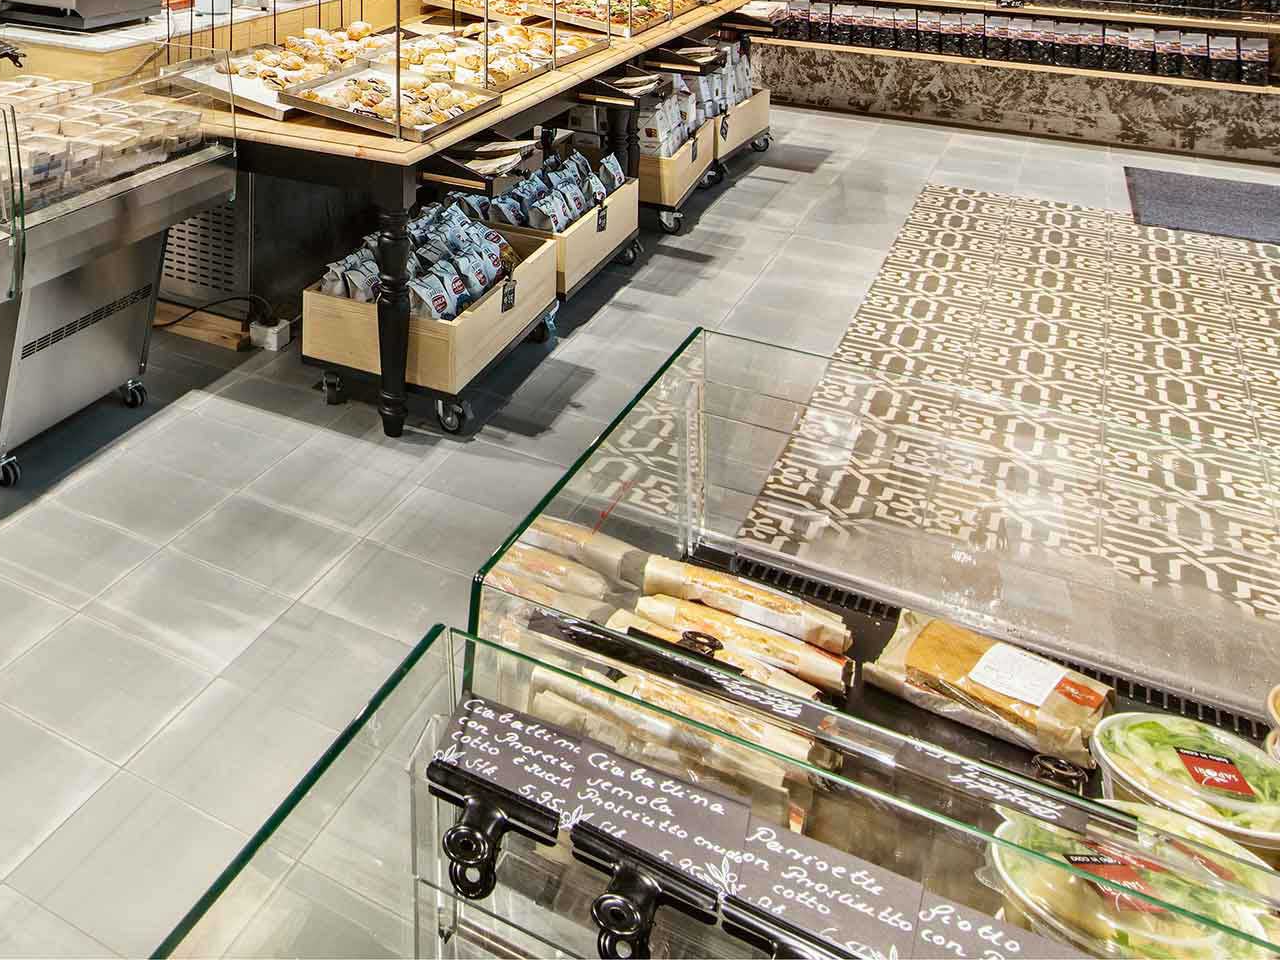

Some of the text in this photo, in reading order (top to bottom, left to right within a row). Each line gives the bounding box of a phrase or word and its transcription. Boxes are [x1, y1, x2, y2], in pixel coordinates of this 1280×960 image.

[459, 716, 489, 736] con
[451, 730, 500, 755] cotto
[586, 777, 675, 817] semola
[588, 753, 725, 816] Ciabattina
[577, 788, 688, 839] Prosciutto
[772, 885, 831, 915] cotto
[921, 929, 967, 957] con
